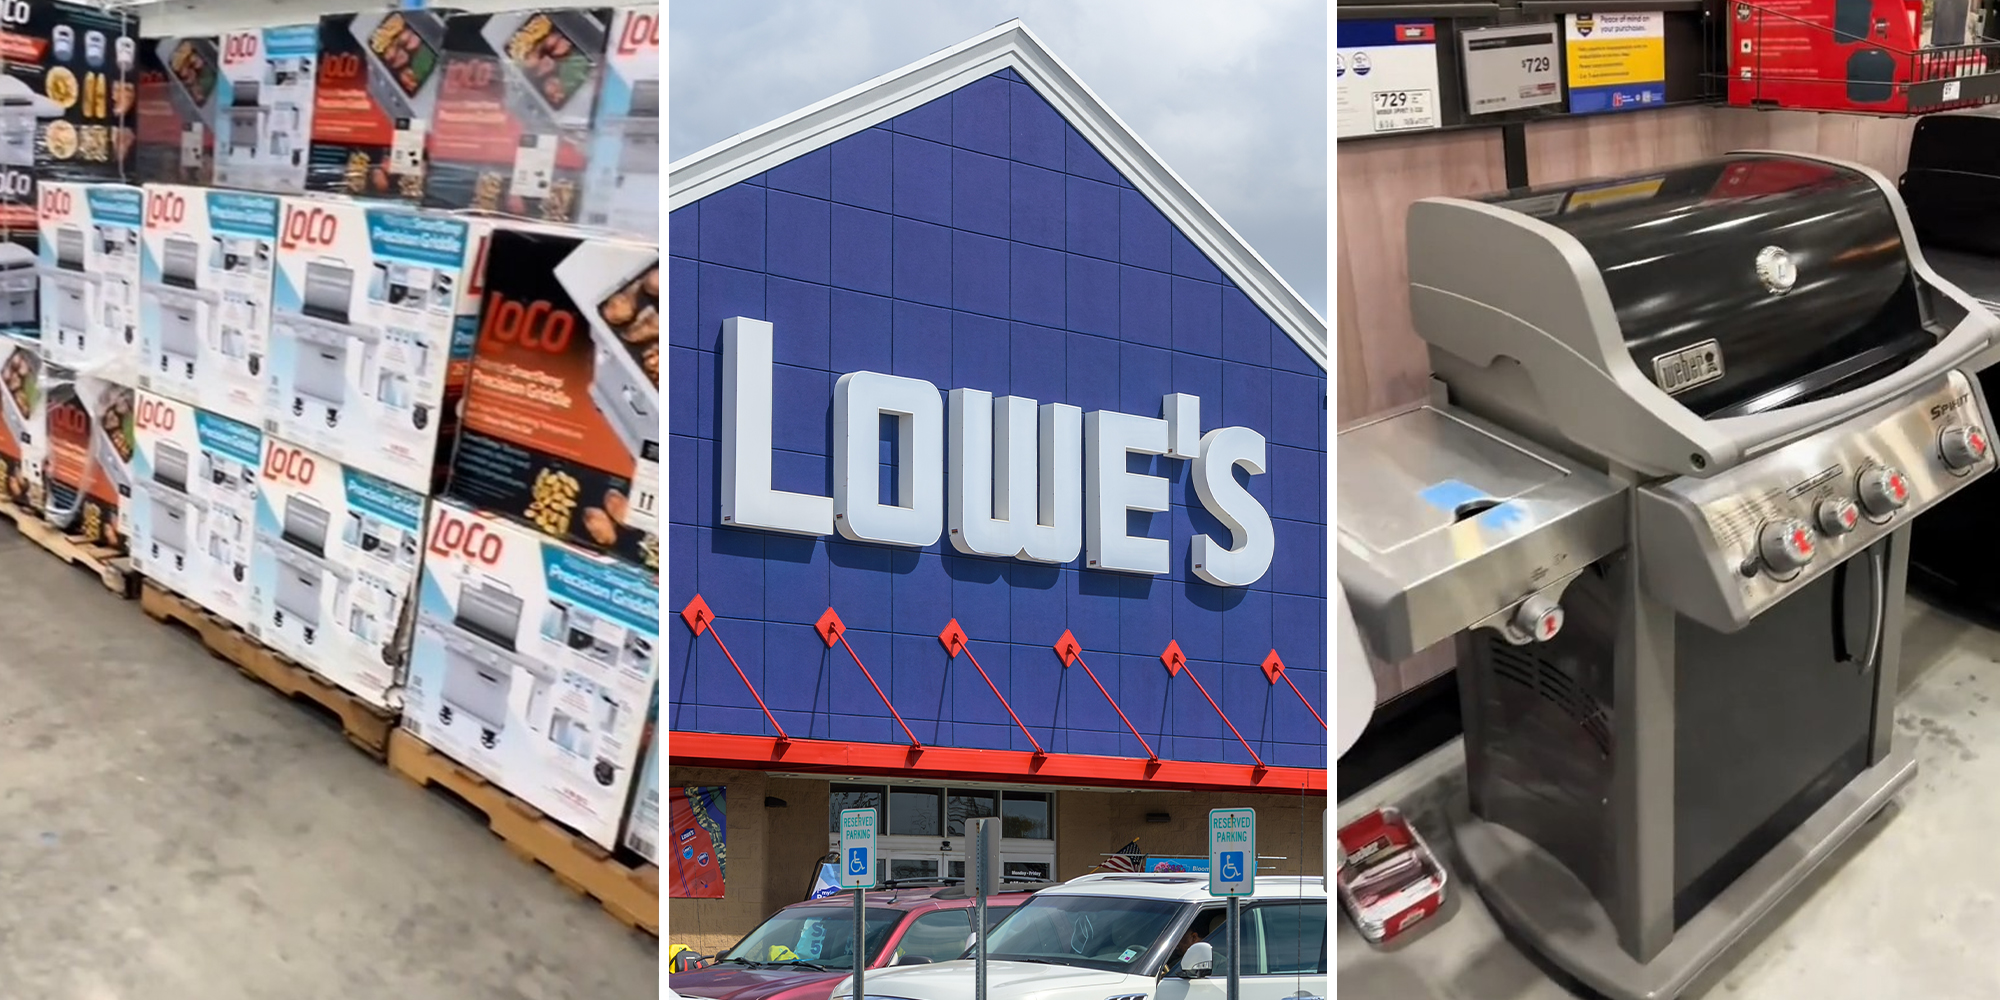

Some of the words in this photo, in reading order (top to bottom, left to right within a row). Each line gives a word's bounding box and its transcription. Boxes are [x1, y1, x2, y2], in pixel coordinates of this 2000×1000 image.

[1600, 15, 1618, 23] Peace
[1620, 14, 1626, 23] of
[1627, 15, 1641, 23] mind
[1521, 56, 1550, 73] $729
[1374, 92, 1407, 108] $729
[1661, 352, 1705, 388] weber
[1930, 393, 1969, 421] SPIRIT
[720, 315, 1275, 587] LOWE'S
[844, 816, 874, 828] RESERVED
[1213, 816, 1251, 829] RESERVED
[846, 829, 871, 840] PARKING
[1216, 831, 1247, 843] PARKING
